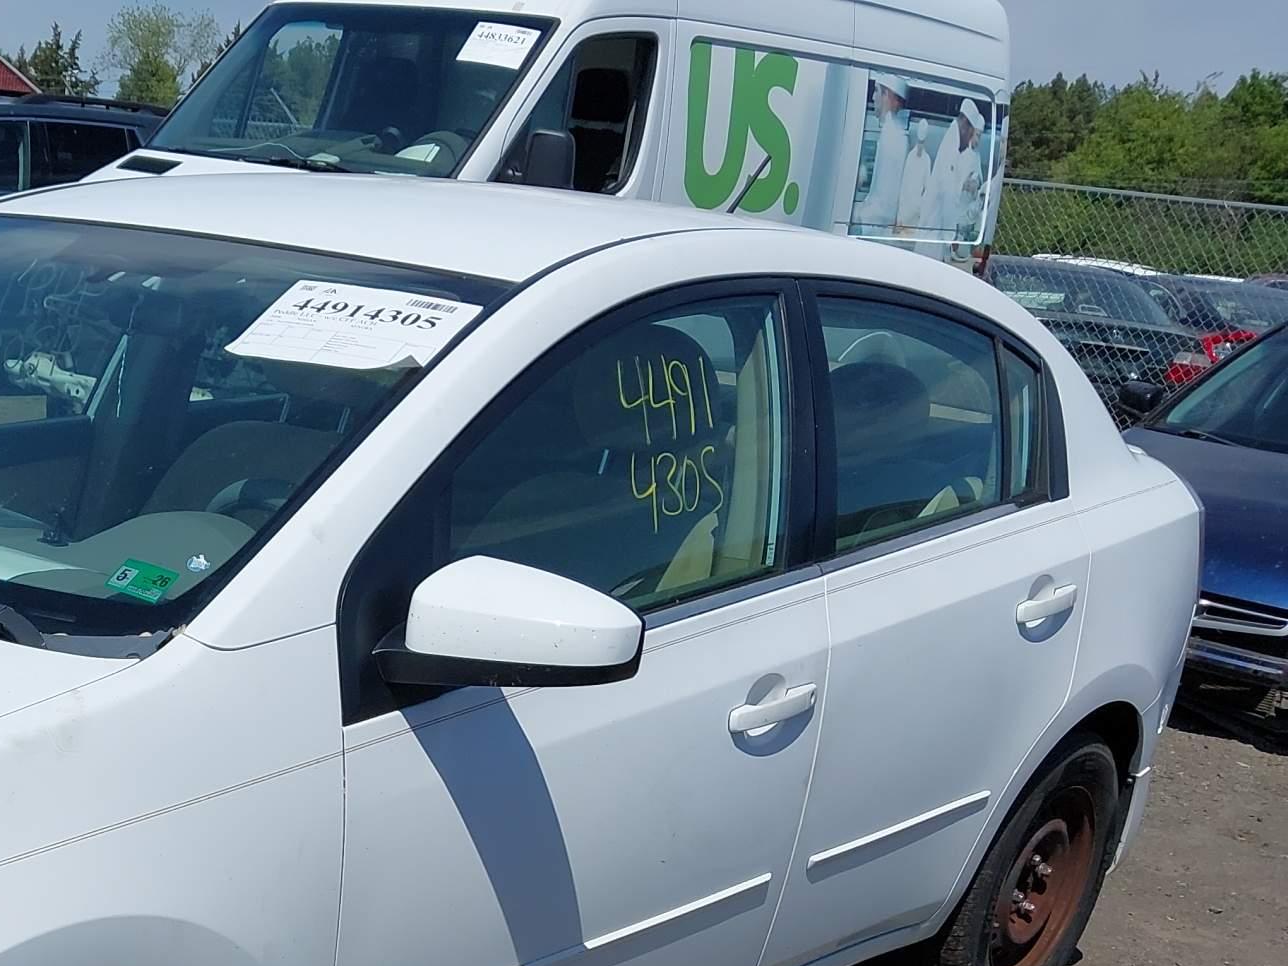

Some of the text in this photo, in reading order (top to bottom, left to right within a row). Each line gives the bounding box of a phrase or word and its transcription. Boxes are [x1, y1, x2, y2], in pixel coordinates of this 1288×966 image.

[477, 31, 526, 46] 44833621
[684, 36, 800, 216] US.
[292, 298, 443, 331] 44914305
[616, 354, 714, 445] 4491
[630, 445, 724, 534] 4305
[115, 568, 132, 582] 5
[153, 574, 172, 588] 26
